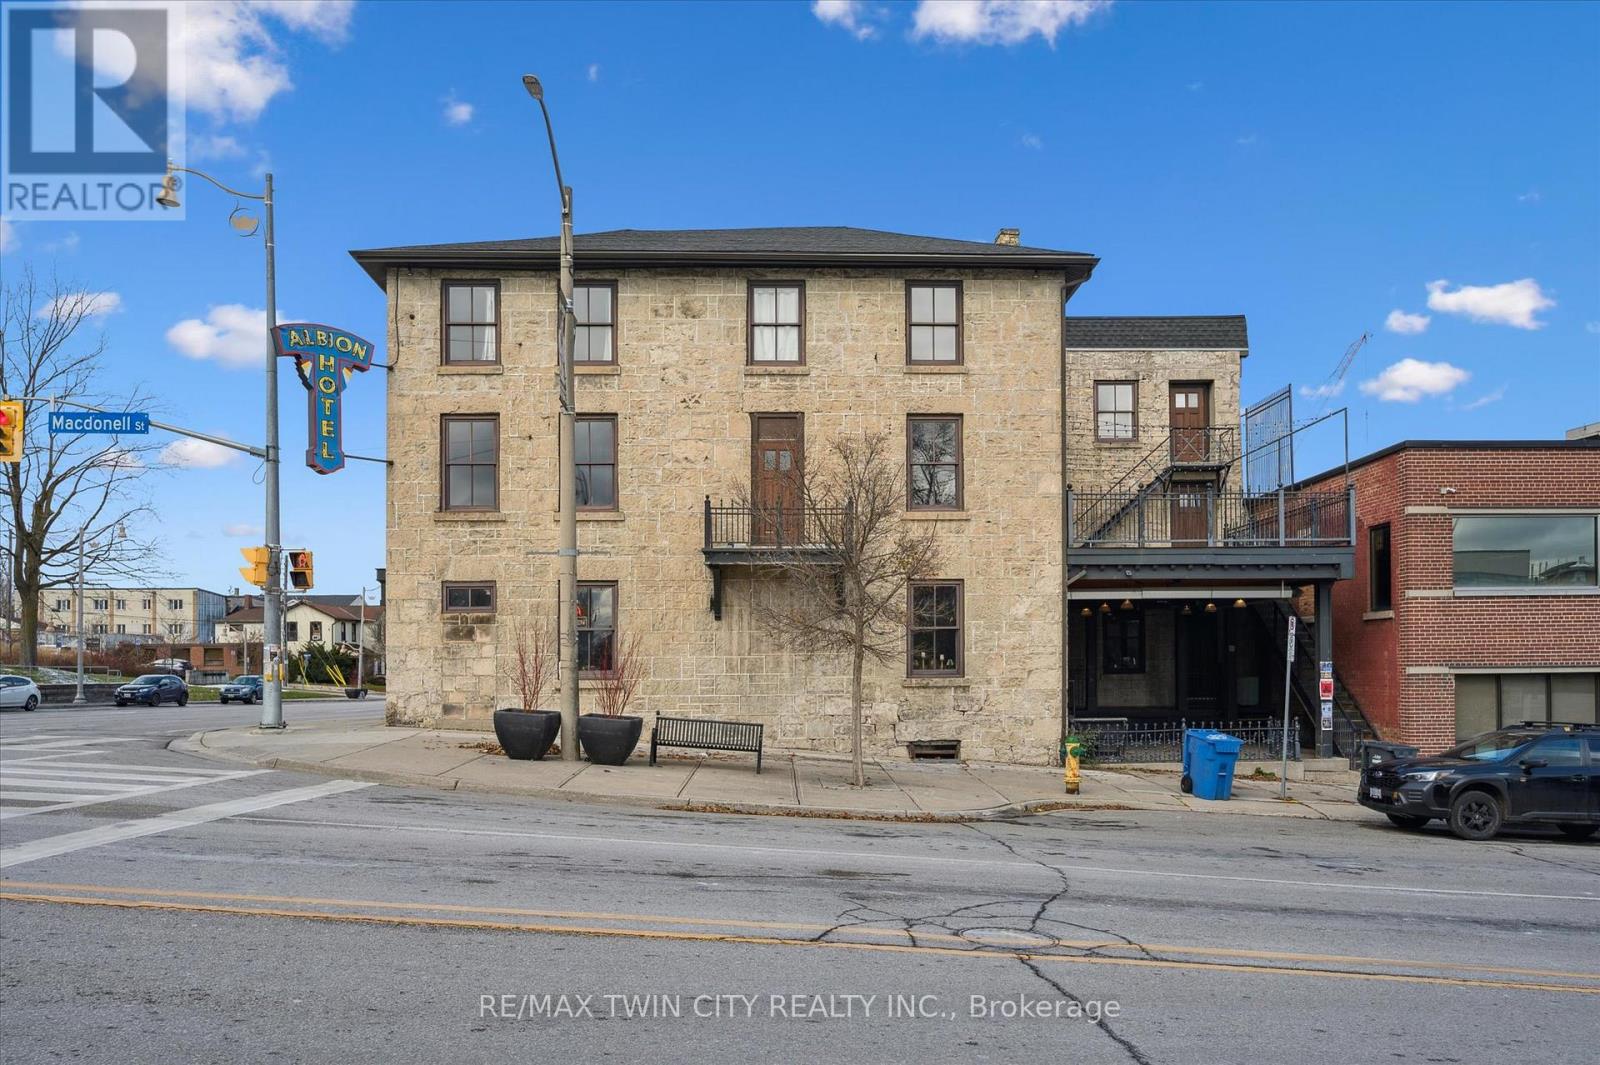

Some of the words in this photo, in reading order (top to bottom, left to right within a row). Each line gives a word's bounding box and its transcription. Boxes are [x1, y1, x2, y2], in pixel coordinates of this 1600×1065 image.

[289, 330, 367, 360] ALBION
[319, 354, 336, 459] HOTEL
[52, 415, 130, 431] Macdonell
[135, 420, 145, 431] St
